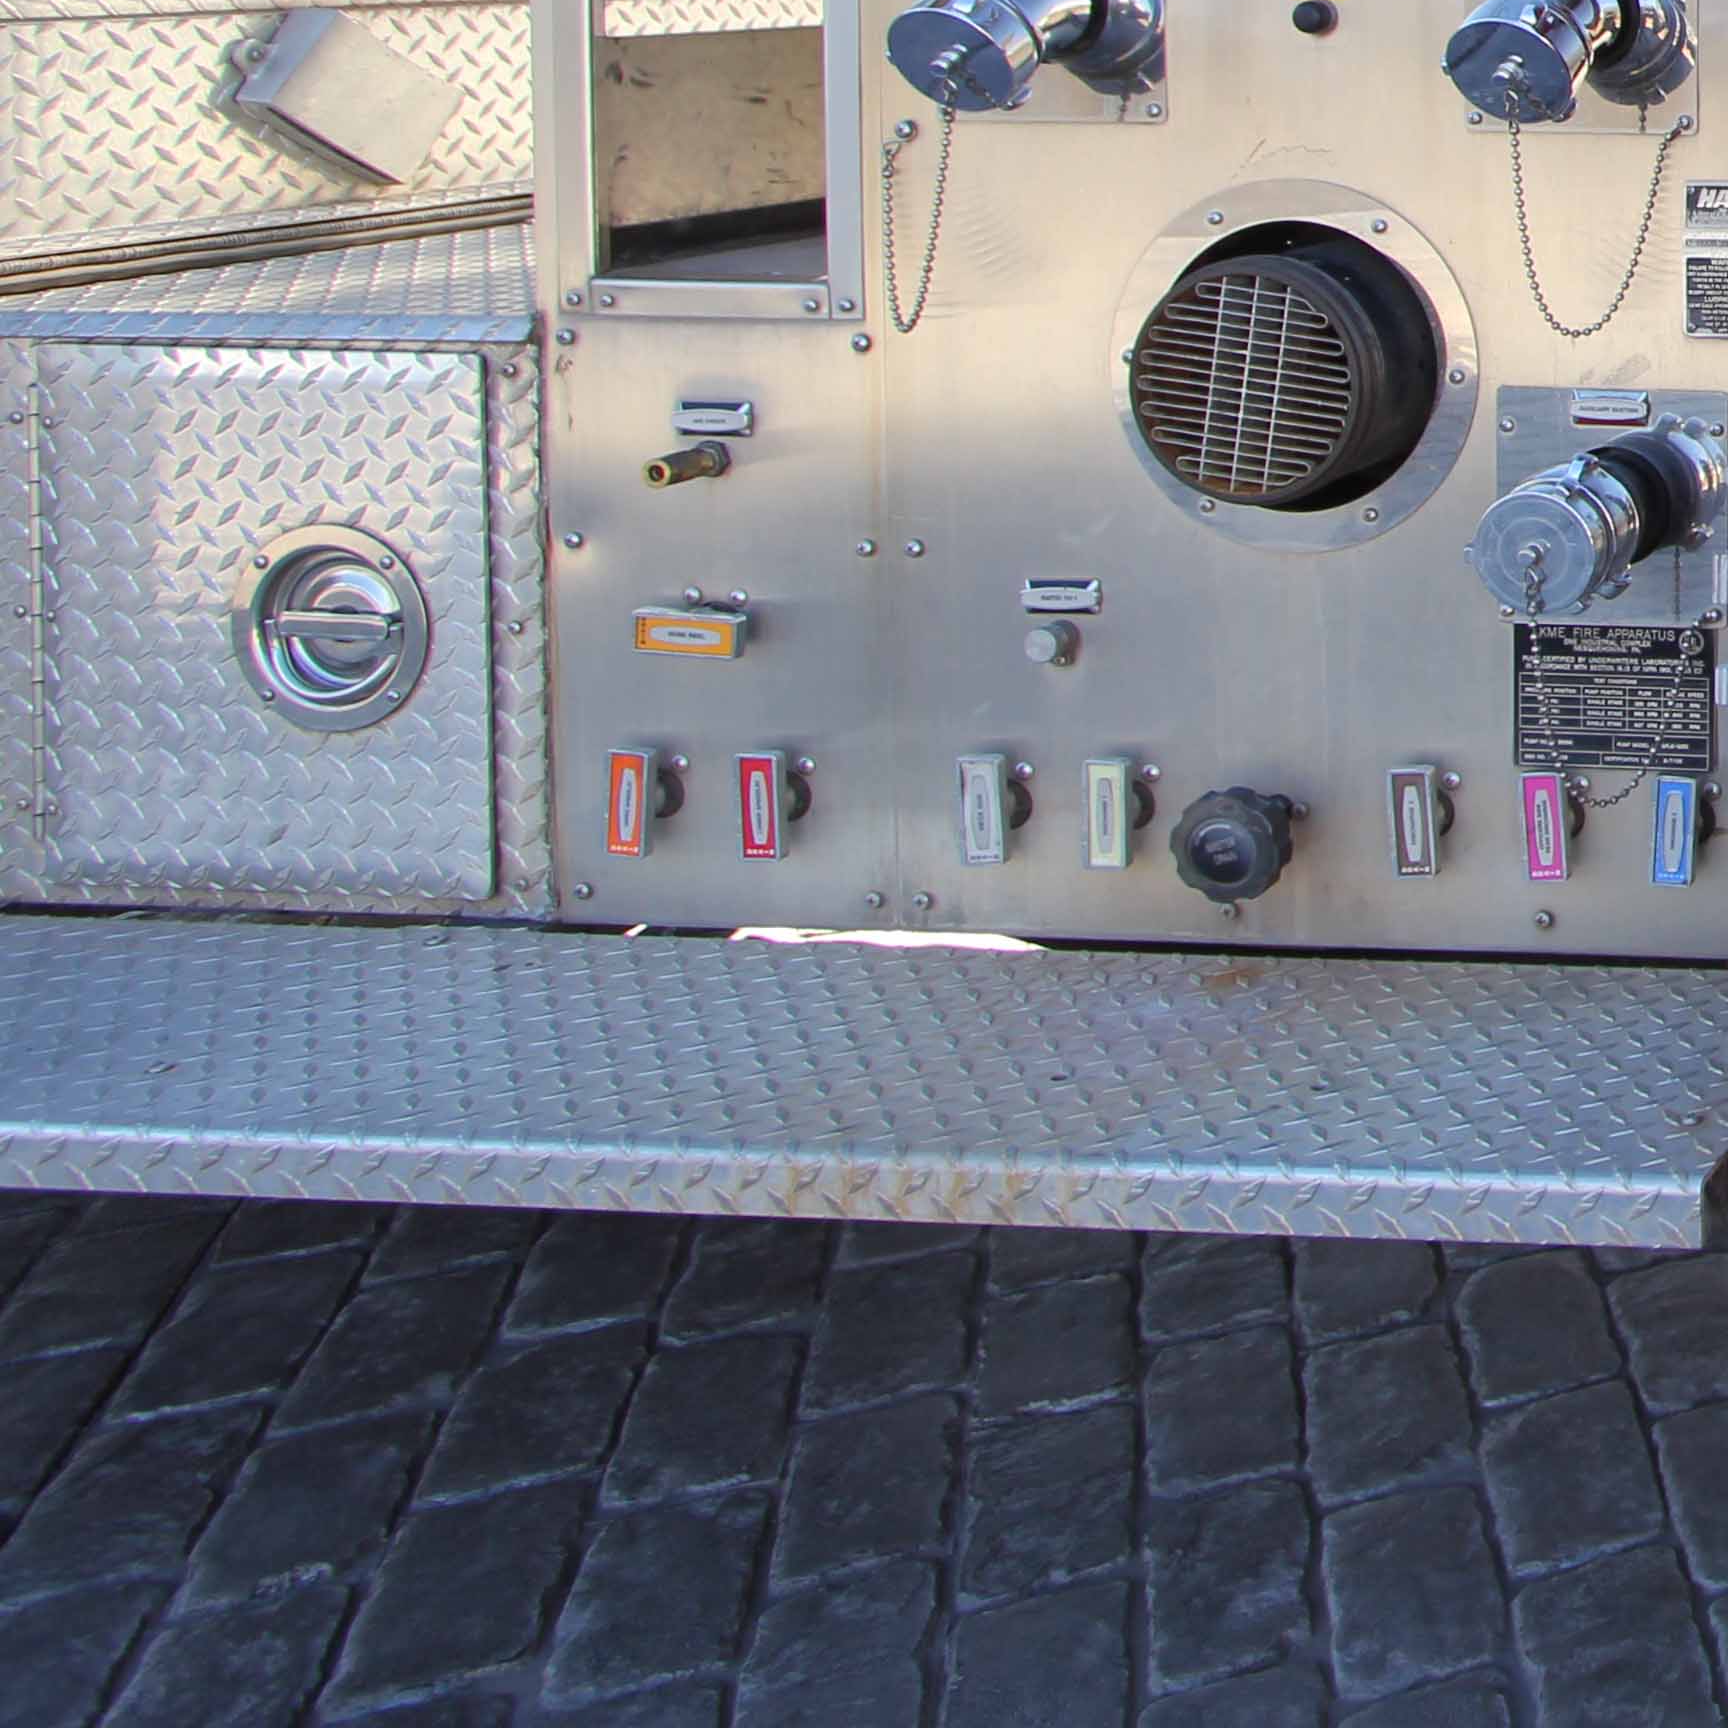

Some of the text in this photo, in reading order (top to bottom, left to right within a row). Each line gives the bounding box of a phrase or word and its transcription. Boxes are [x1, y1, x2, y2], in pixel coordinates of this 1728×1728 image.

[1539, 627, 1676, 642] KME FIRE APPARATUS
